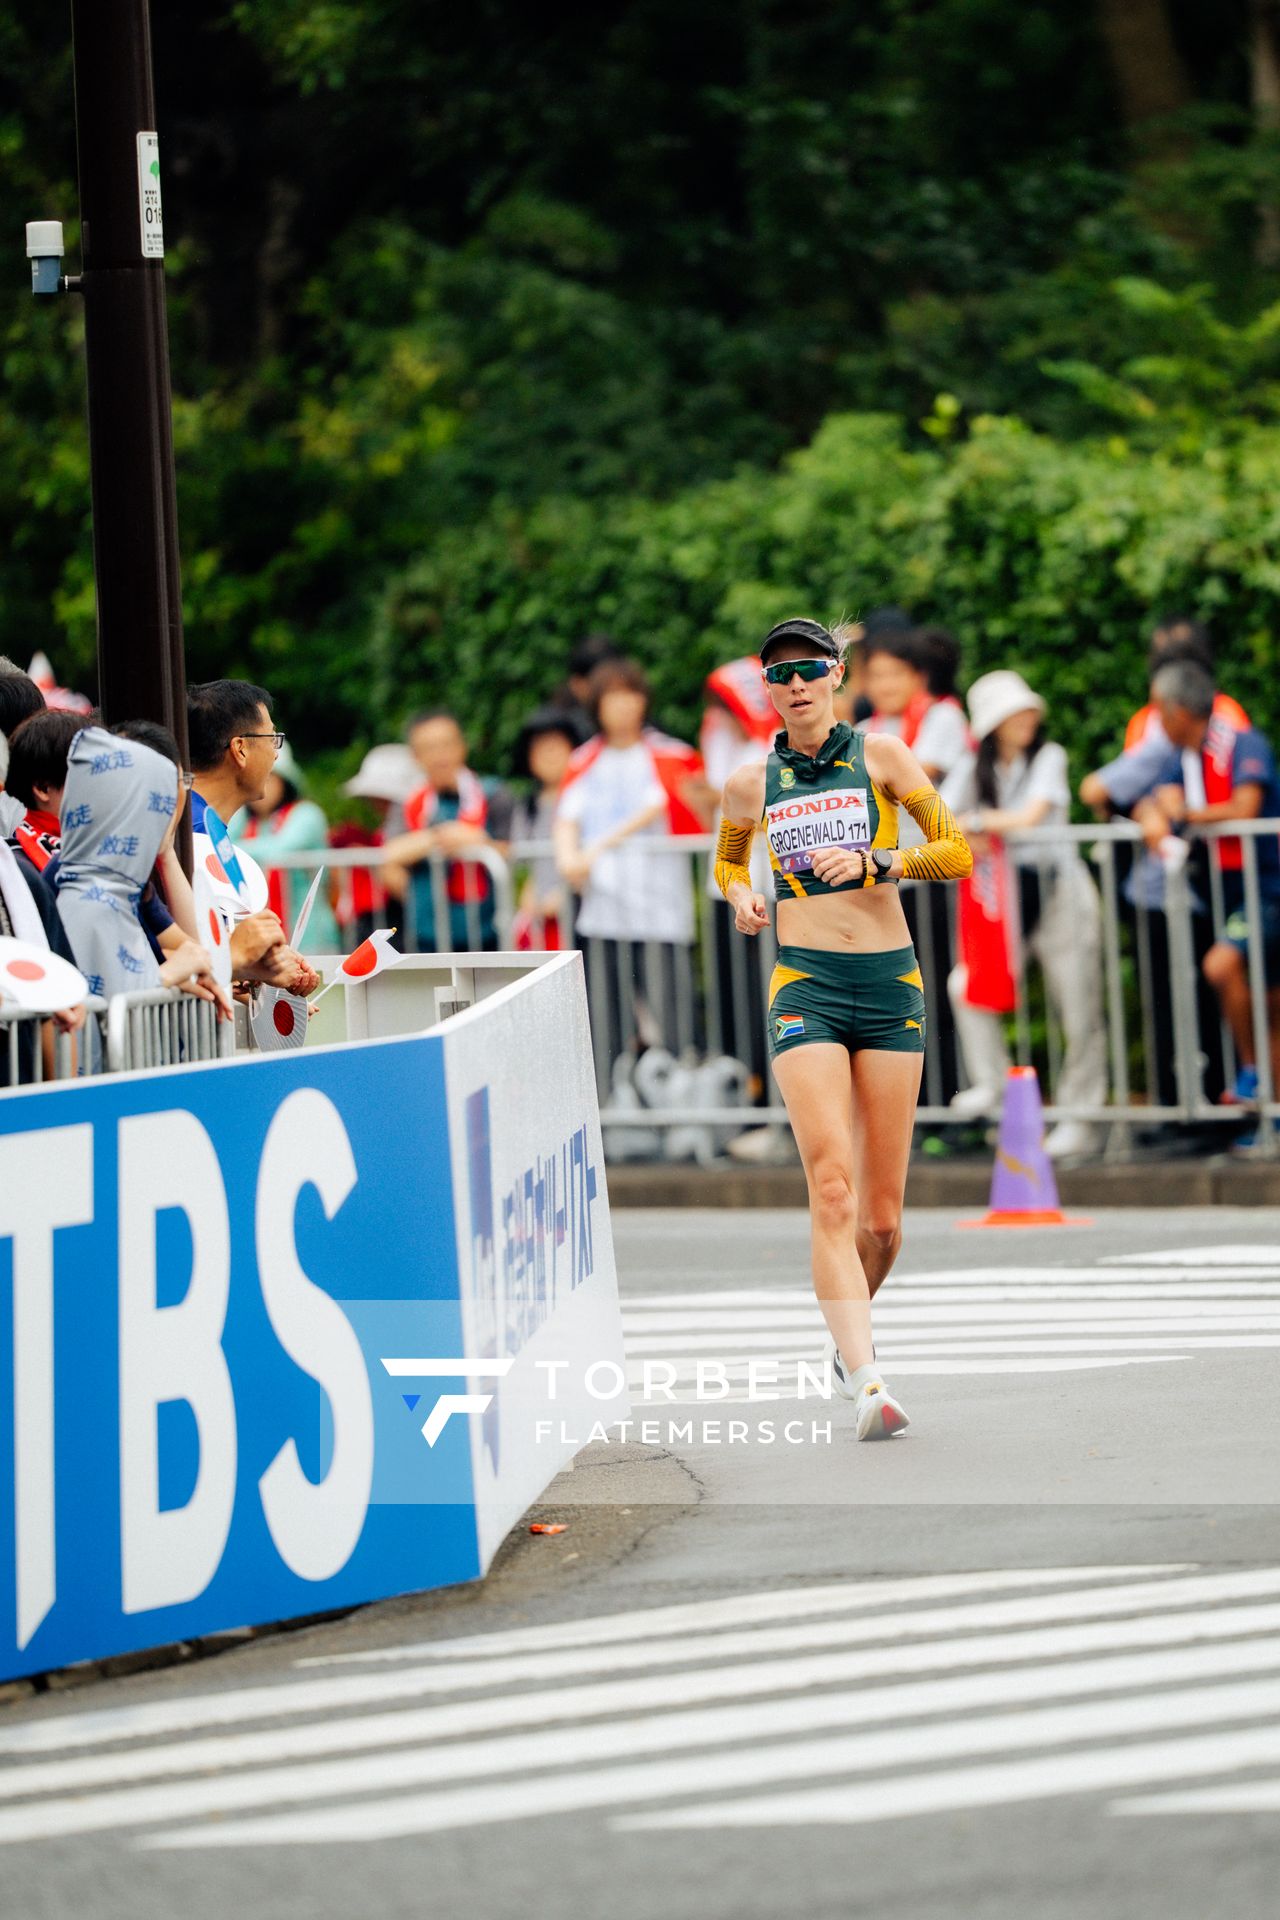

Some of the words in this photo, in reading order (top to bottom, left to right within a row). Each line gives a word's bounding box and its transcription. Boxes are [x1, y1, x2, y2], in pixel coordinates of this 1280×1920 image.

[768, 796, 865, 824] HONDA
[770, 820, 845, 854] GROENEWALD
[848, 822, 868, 840] 171
[0, 1087, 374, 1652] TBS
